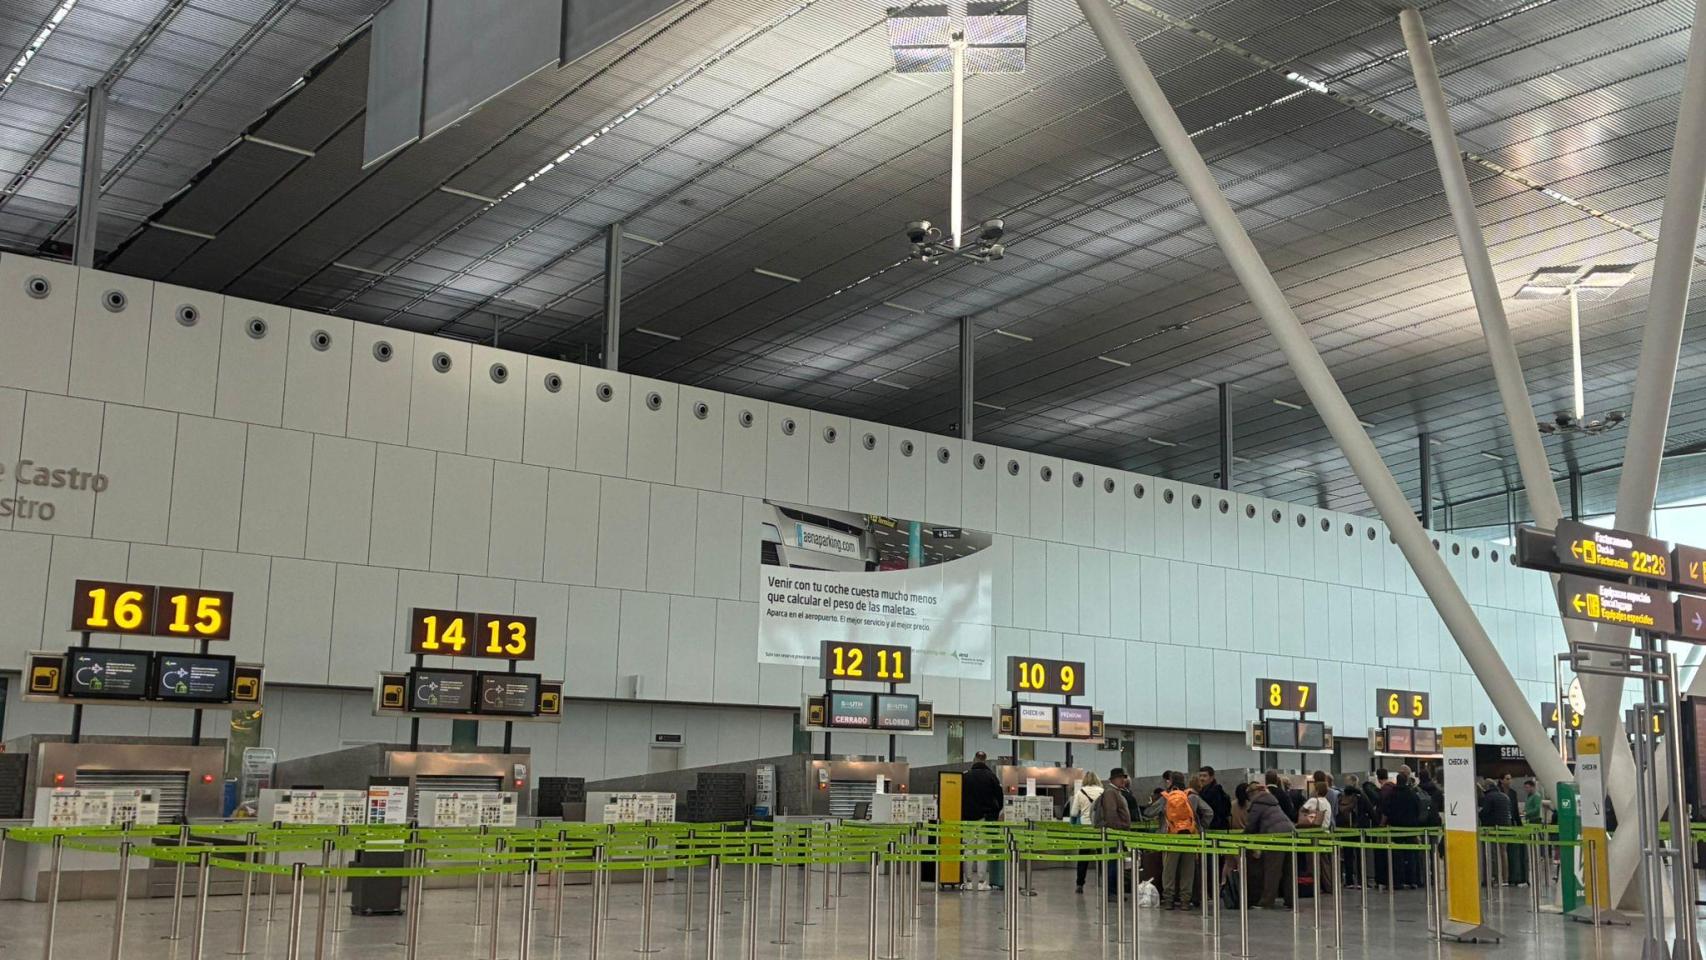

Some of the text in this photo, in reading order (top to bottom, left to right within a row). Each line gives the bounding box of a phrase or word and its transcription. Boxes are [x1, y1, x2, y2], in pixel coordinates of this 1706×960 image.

[15, 460, 109, 493] Castro
[0, 496, 56, 520] stro
[803, 530, 856, 552] aenaparking.com
[1632, 550, 1666, 576] 22:28
[768, 576, 937, 604] Venir con tu coche cuesta mucho menos
[86, 588, 222, 634] 16 15
[768, 593, 917, 616] que calcular el peso de las maletas.
[766, 608, 787, 618] Aparca
[805, 613, 838, 622] aeropuerto.
[847, 617, 862, 625] mejor
[864, 618, 885, 626] servicio
[897, 622, 912, 630] mejor
[1626, 614, 1654, 625] especiales
[422, 616, 527, 654] 14 13
[832, 647, 904, 679] 12 11
[1019, 662, 1074, 692] 10 9
[1270, 684, 1309, 708] 8 7
[1388, 694, 1423, 716] 6 5
[835, 716, 868, 724] CERRADO
[1653, 715, 1660, 733] 1
